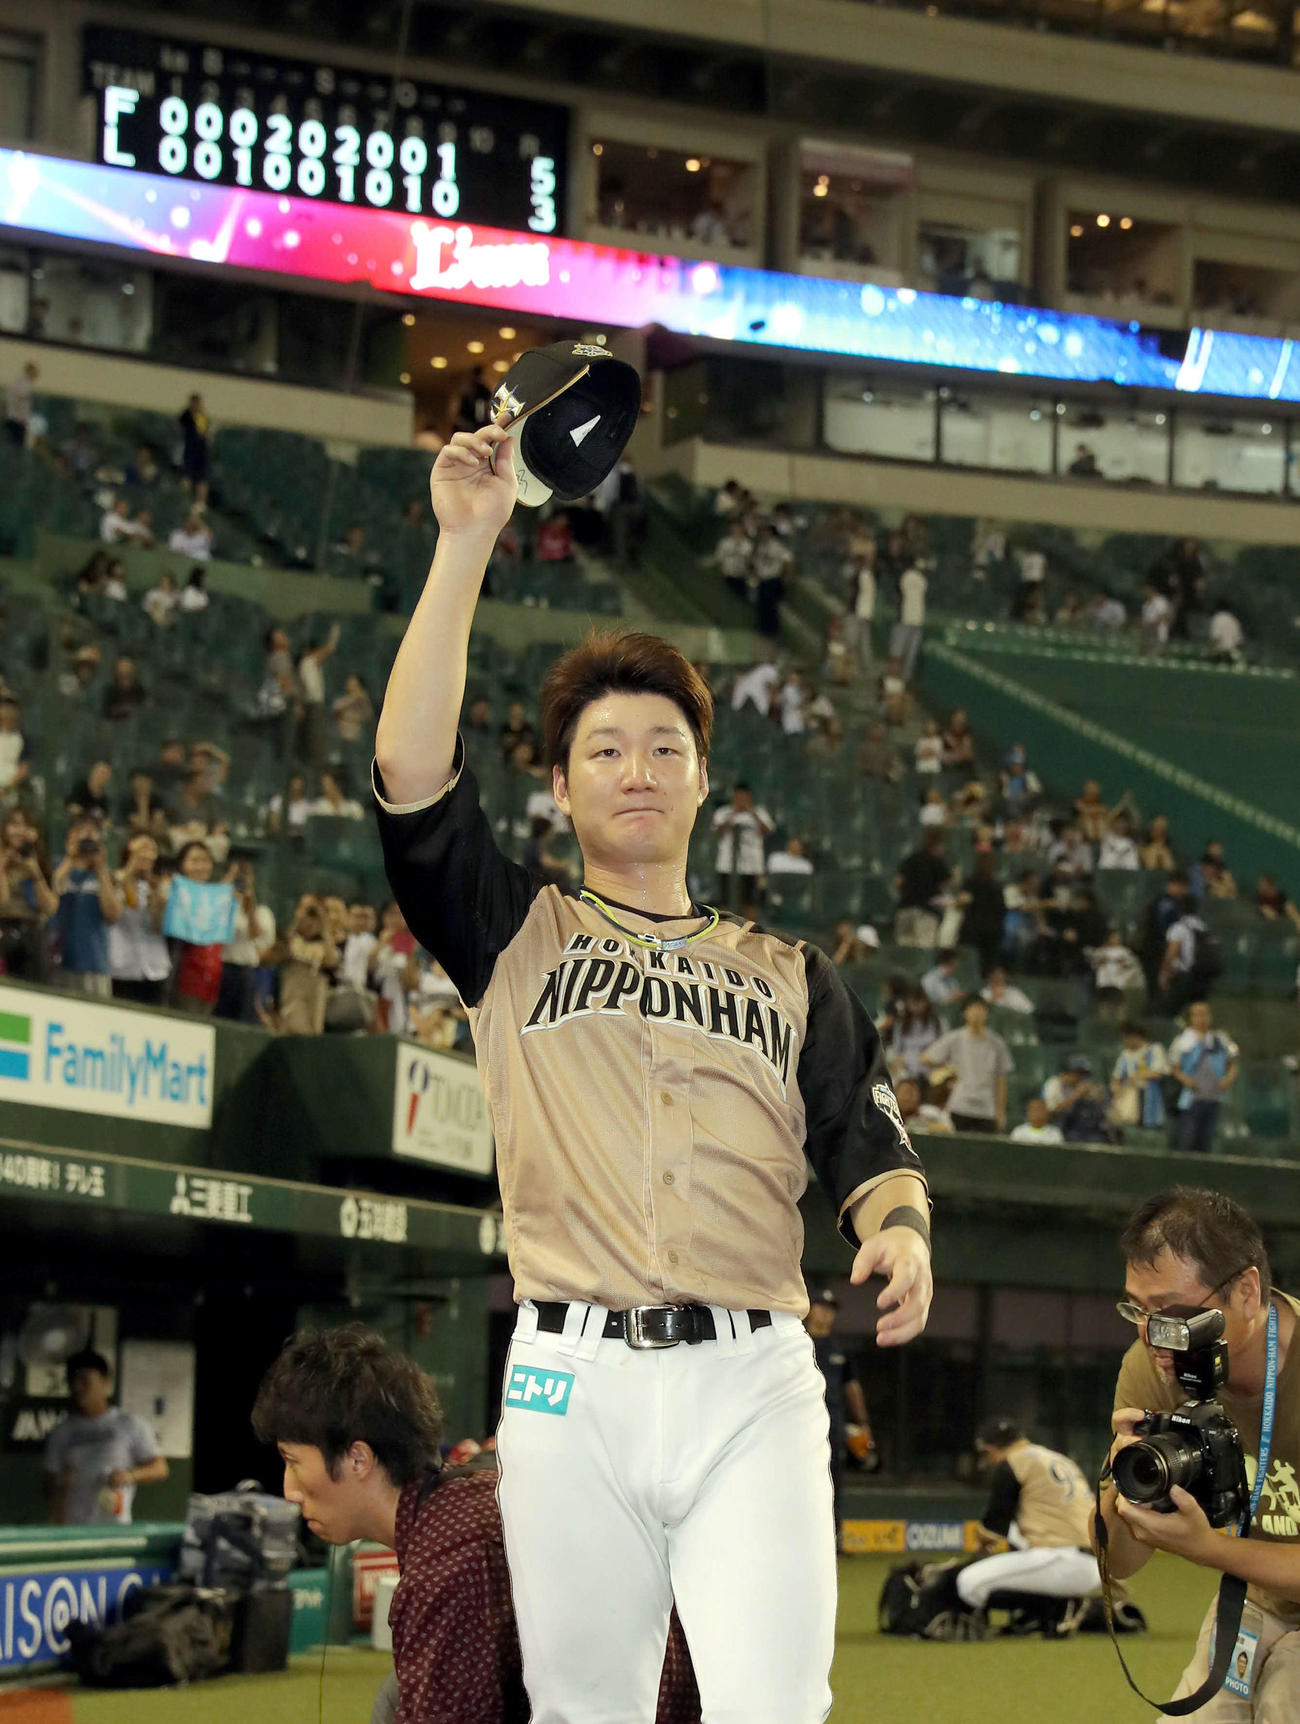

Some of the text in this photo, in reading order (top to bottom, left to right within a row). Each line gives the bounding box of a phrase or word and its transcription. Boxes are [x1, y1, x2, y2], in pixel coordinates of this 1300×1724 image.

[105, 85, 139, 126] F
[530, 156, 557, 198] 5
[103, 126, 137, 168] L
[527, 194, 557, 233] 3
[563, 932, 776, 1003] HOKAIDO
[520, 957, 798, 1098] NIPPONHAM
[44, 1022, 207, 1107] FamilyMart
[508, 1372, 568, 1407] ニトリ
[1266, 1340, 1277, 1389] NIPPON-HAM
[1171, 1414, 1191, 1425] Nikon
[1263, 1391, 1274, 1433] HOKKAIDO
[1224, 1676, 1249, 1696] PHOTO
